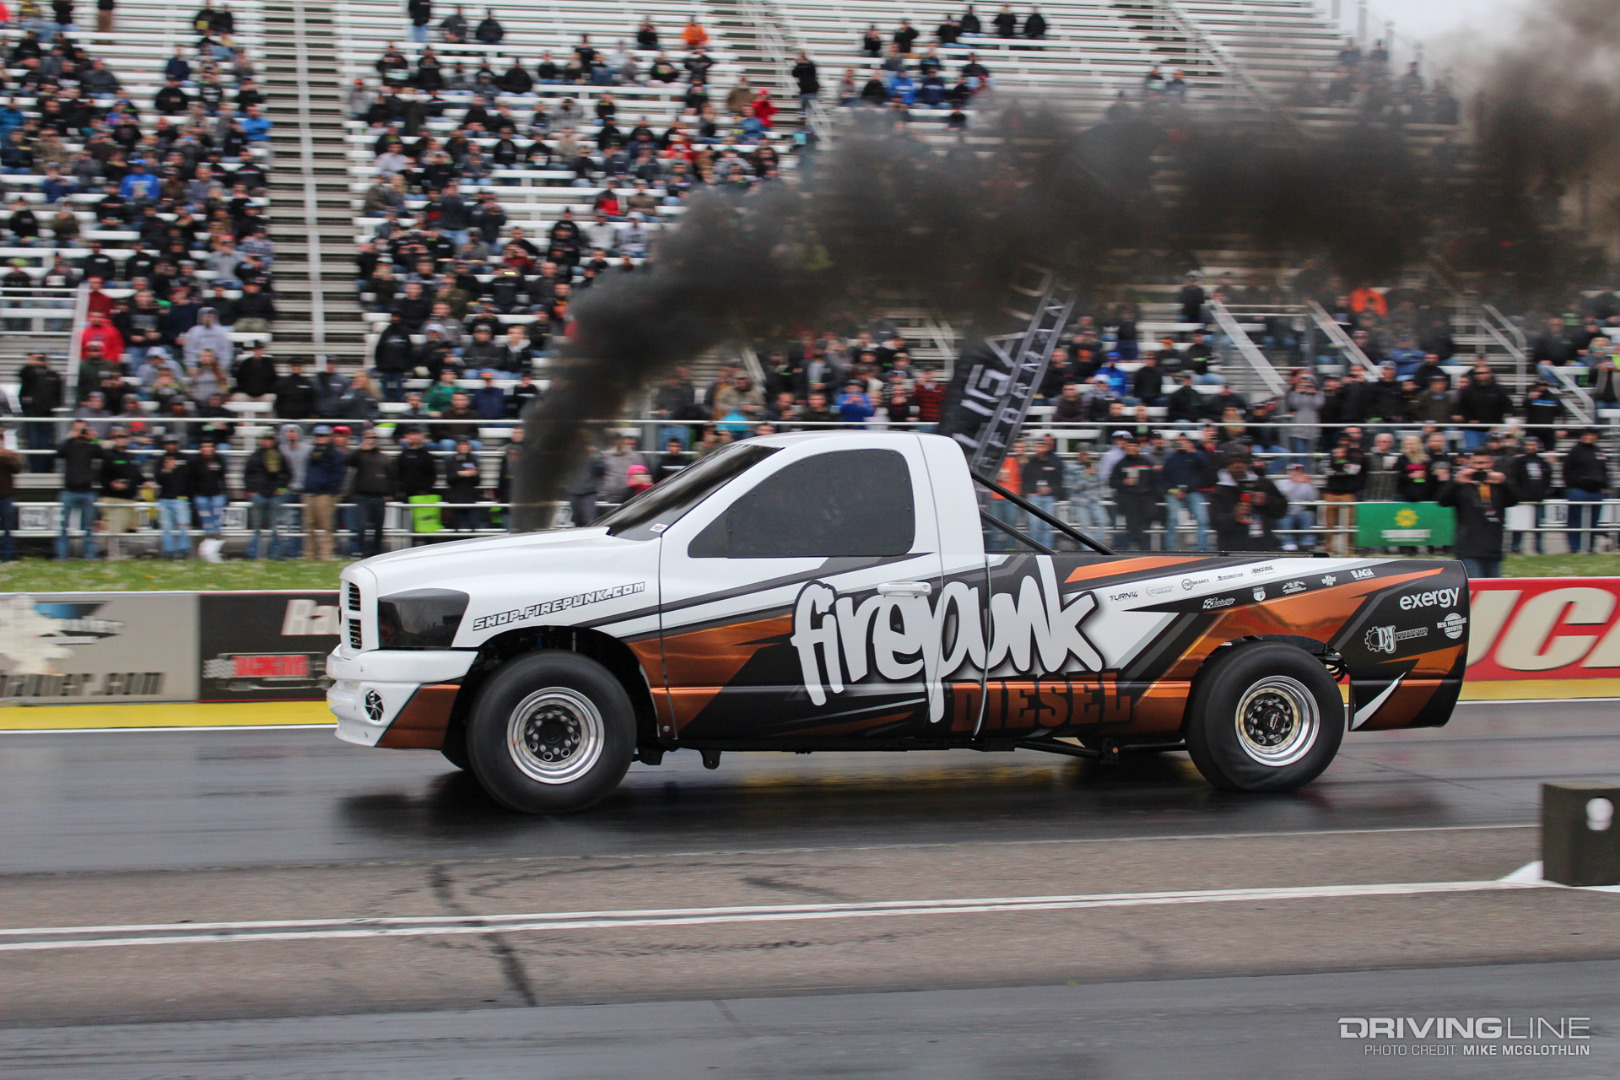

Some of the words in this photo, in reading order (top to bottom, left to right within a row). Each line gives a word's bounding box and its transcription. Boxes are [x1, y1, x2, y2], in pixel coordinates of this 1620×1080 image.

[473, 581, 645, 632] SHOP.FIREPUNK.COM
[1400, 587, 1460, 611] exergy
[790, 554, 1104, 724] firepunk
[950, 672, 1133, 733] DIESEL
